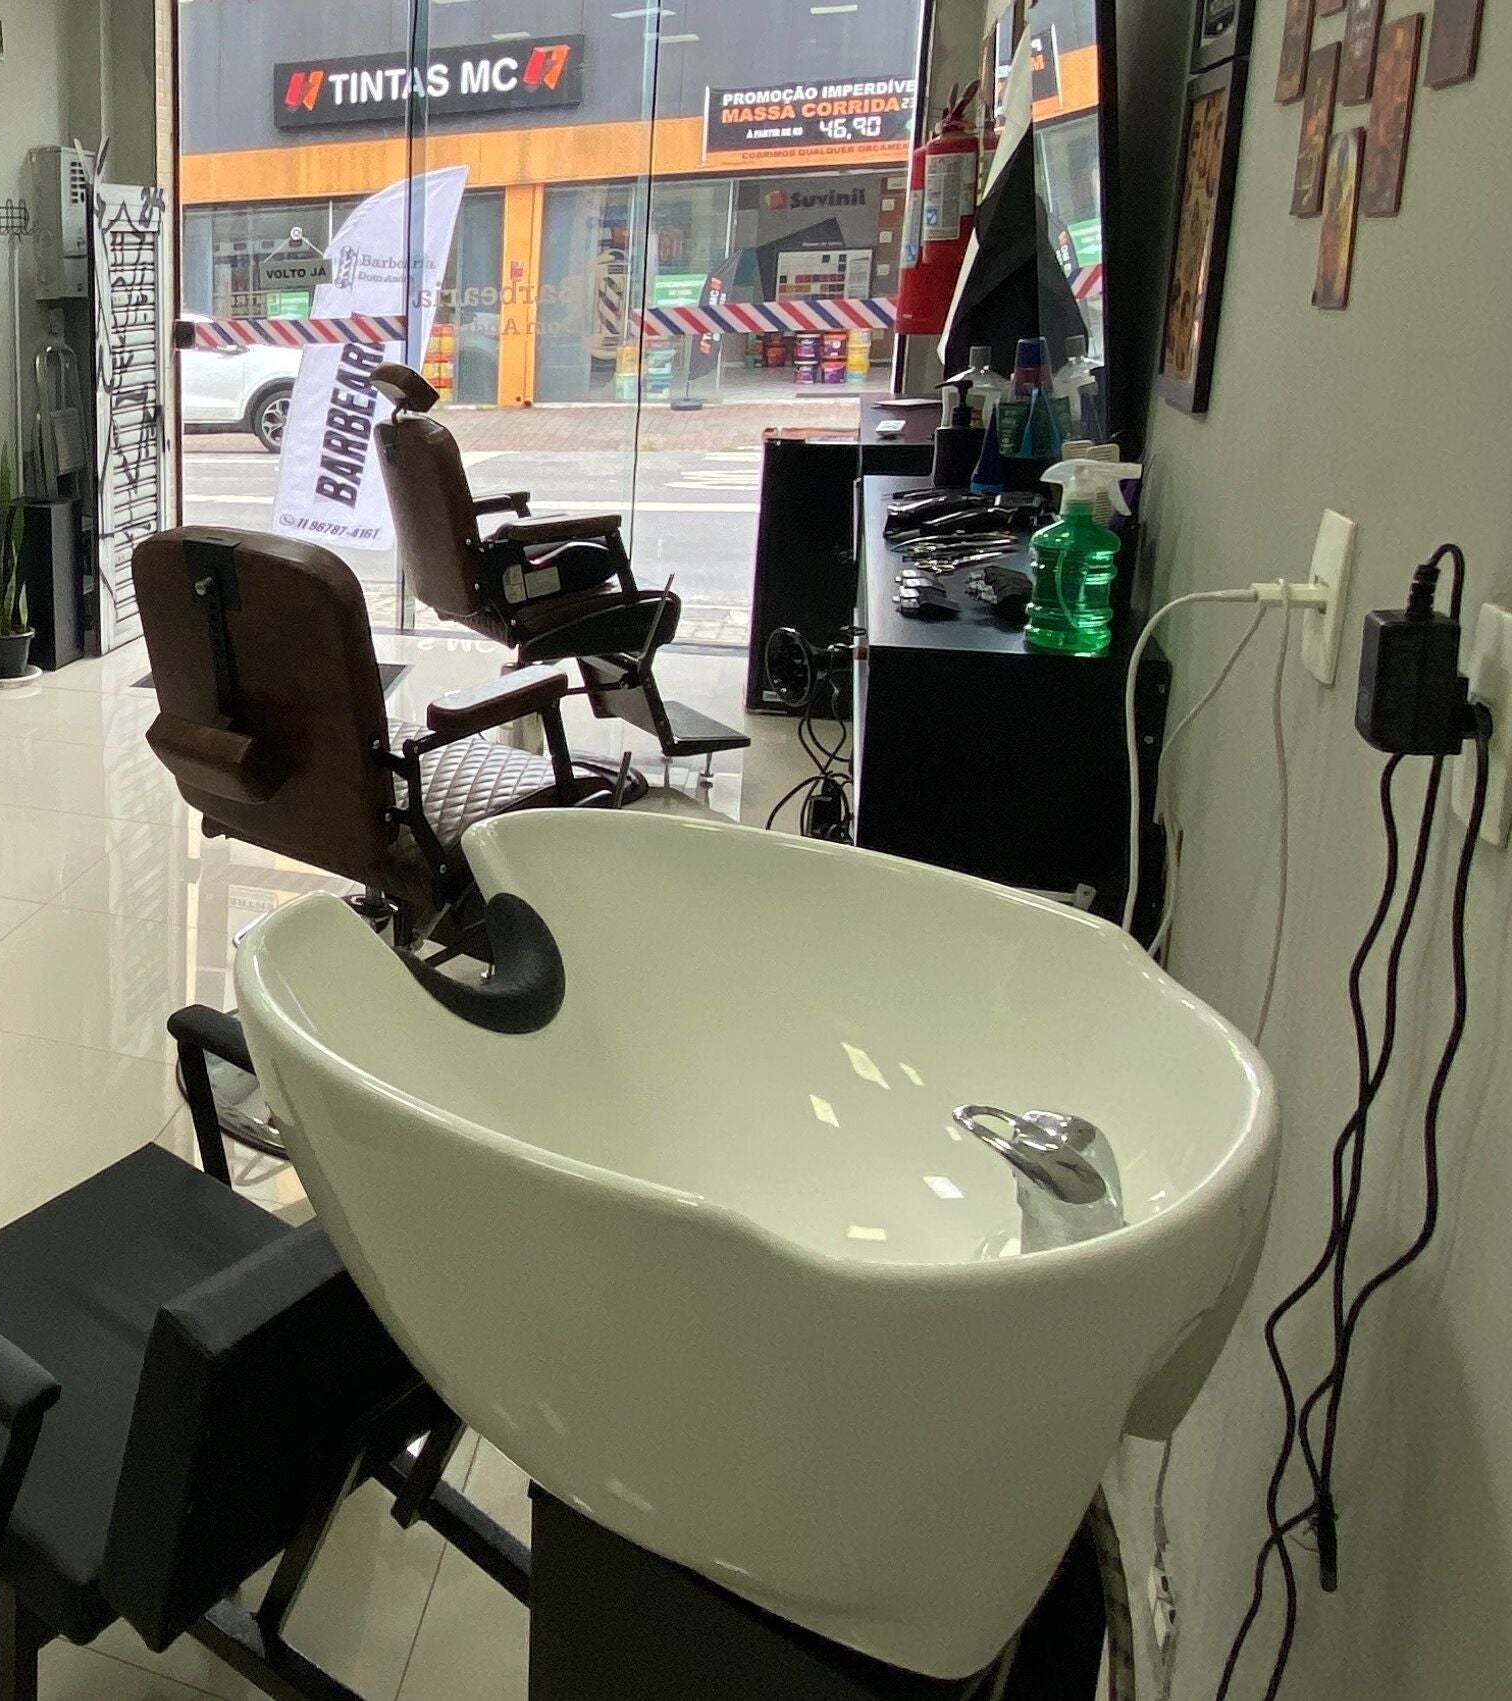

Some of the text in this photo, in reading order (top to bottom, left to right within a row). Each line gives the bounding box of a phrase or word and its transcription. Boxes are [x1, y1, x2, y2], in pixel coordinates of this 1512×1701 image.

[329, 58, 518, 105] TINTAS MC
[722, 79, 916, 106] PROMOÇÃO IMPERDÍVE
[721, 106, 796, 124] MASSA
[801, 97, 901, 118] CORRIDA
[742, 150, 796, 159] COBRIMOS
[798, 147, 855, 156] QUALQUER
[791, 188, 866, 208] Suvinil
[266, 266, 327, 279] VOLTO JÁ
[315, 342, 386, 509] BARBEARI
[296, 518, 308, 529] 11
